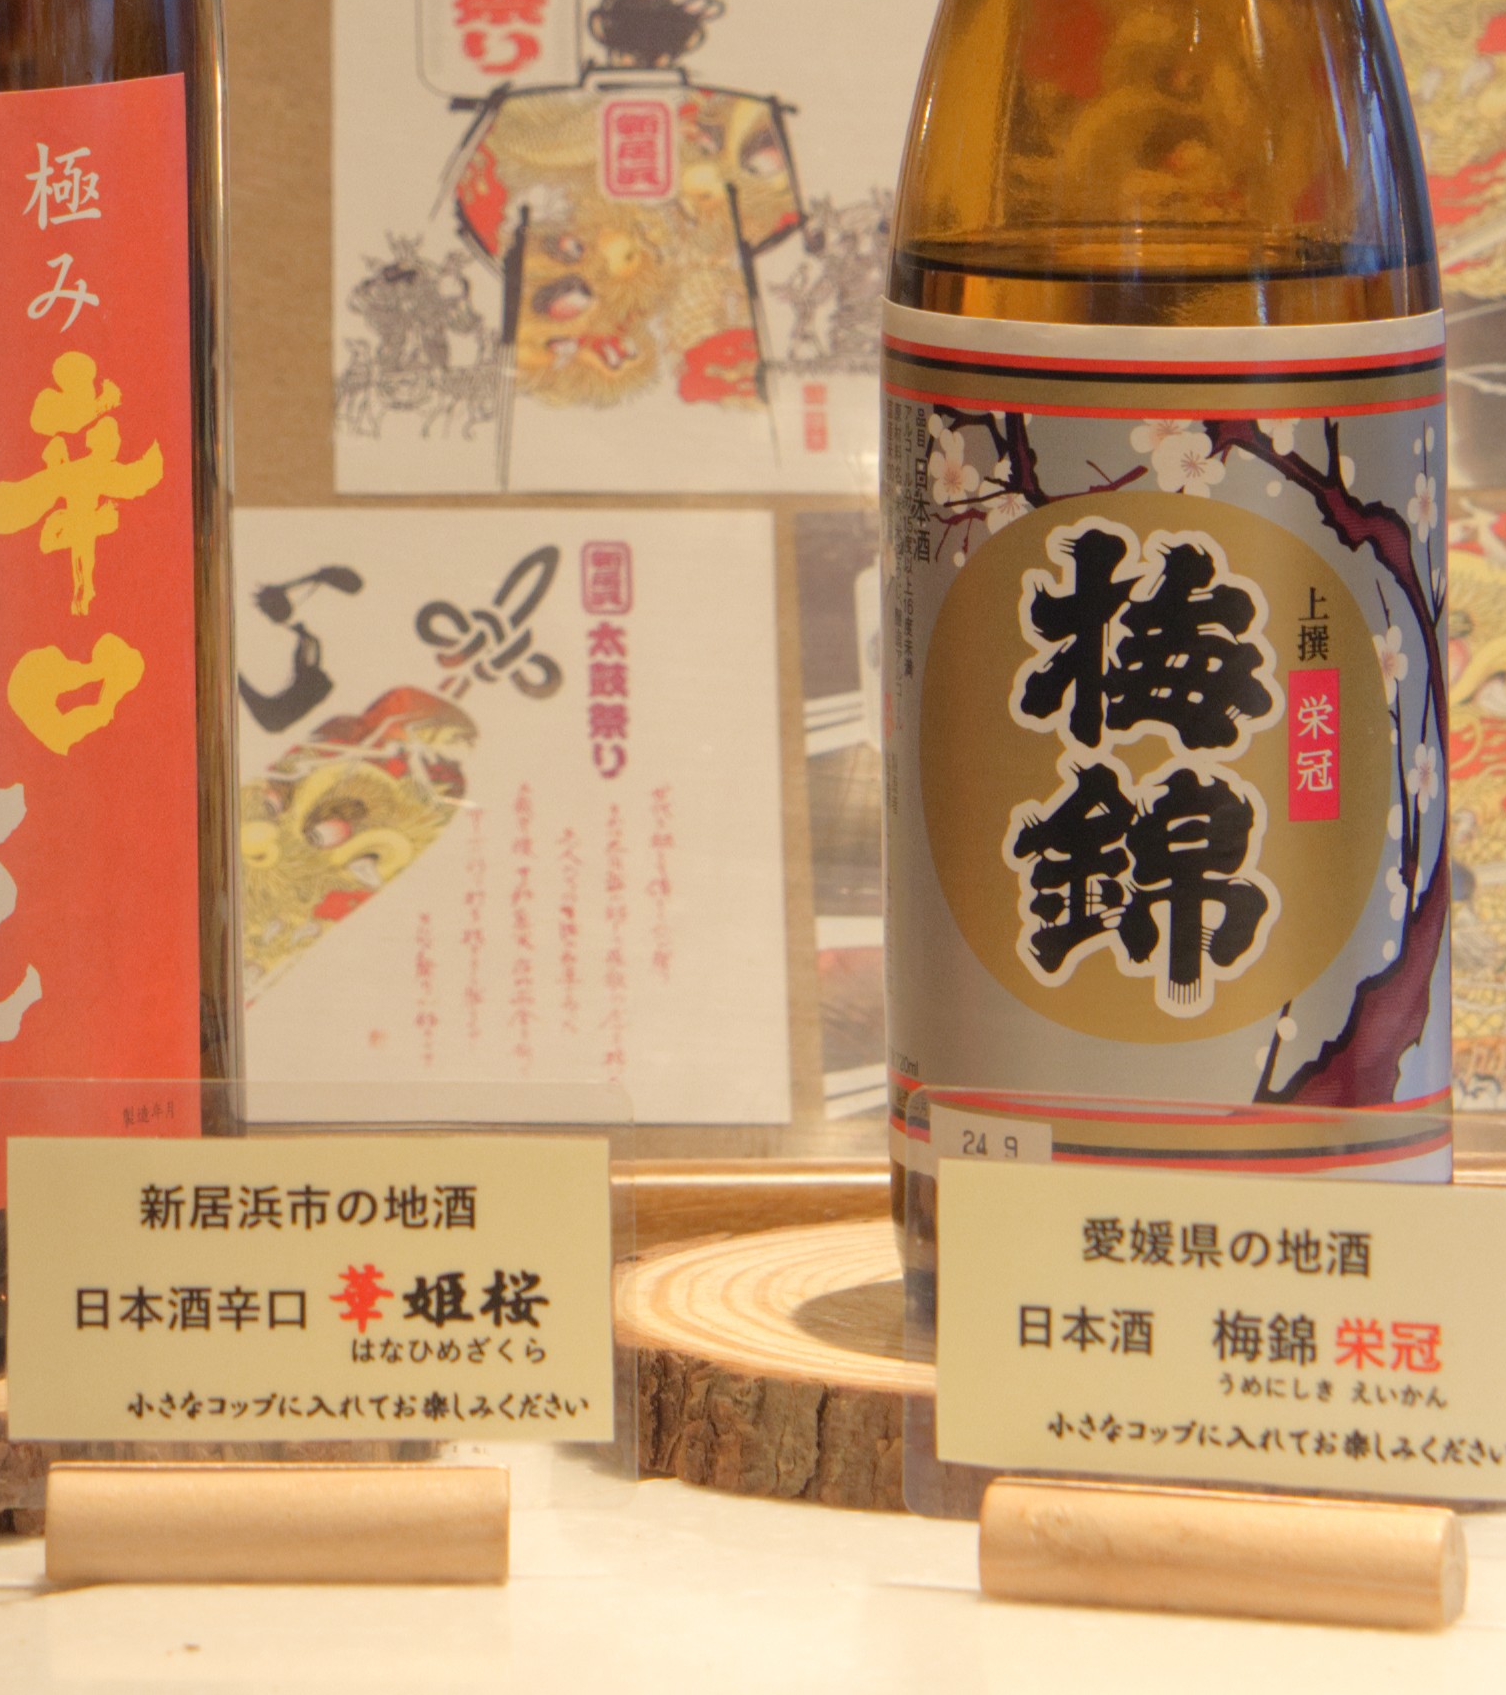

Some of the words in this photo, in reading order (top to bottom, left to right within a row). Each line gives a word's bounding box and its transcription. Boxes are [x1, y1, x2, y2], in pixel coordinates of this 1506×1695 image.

[22, 142, 102, 333] 極み
[1298, 586, 1329, 661] 上撰
[1014, 528, 1272, 1006] 梅錦
[1296, 695, 1334, 791] 栄冠
[963, 1130, 987, 1156] 24
[140, 1185, 477, 1229] 新居浜市の地酒
[1083, 1217, 1372, 1277] 愛媛県の地酒
[75, 1287, 307, 1331] 日本酒辛口
[329, 1263, 550, 1333] 華姫桜
[352, 1337, 547, 1364] はなひめざくら
[1017, 1304, 1154, 1355] 日本酒
[1213, 1309, 1317, 1366] 梅錦
[1334, 1317, 1442, 1373] 栄冠
[127, 1391, 590, 1422] 小さなコップに入れてお楽しみください
[1218, 1373, 1334, 1401] うめにしき
[1351, 1382, 1447, 1409] えいかん
